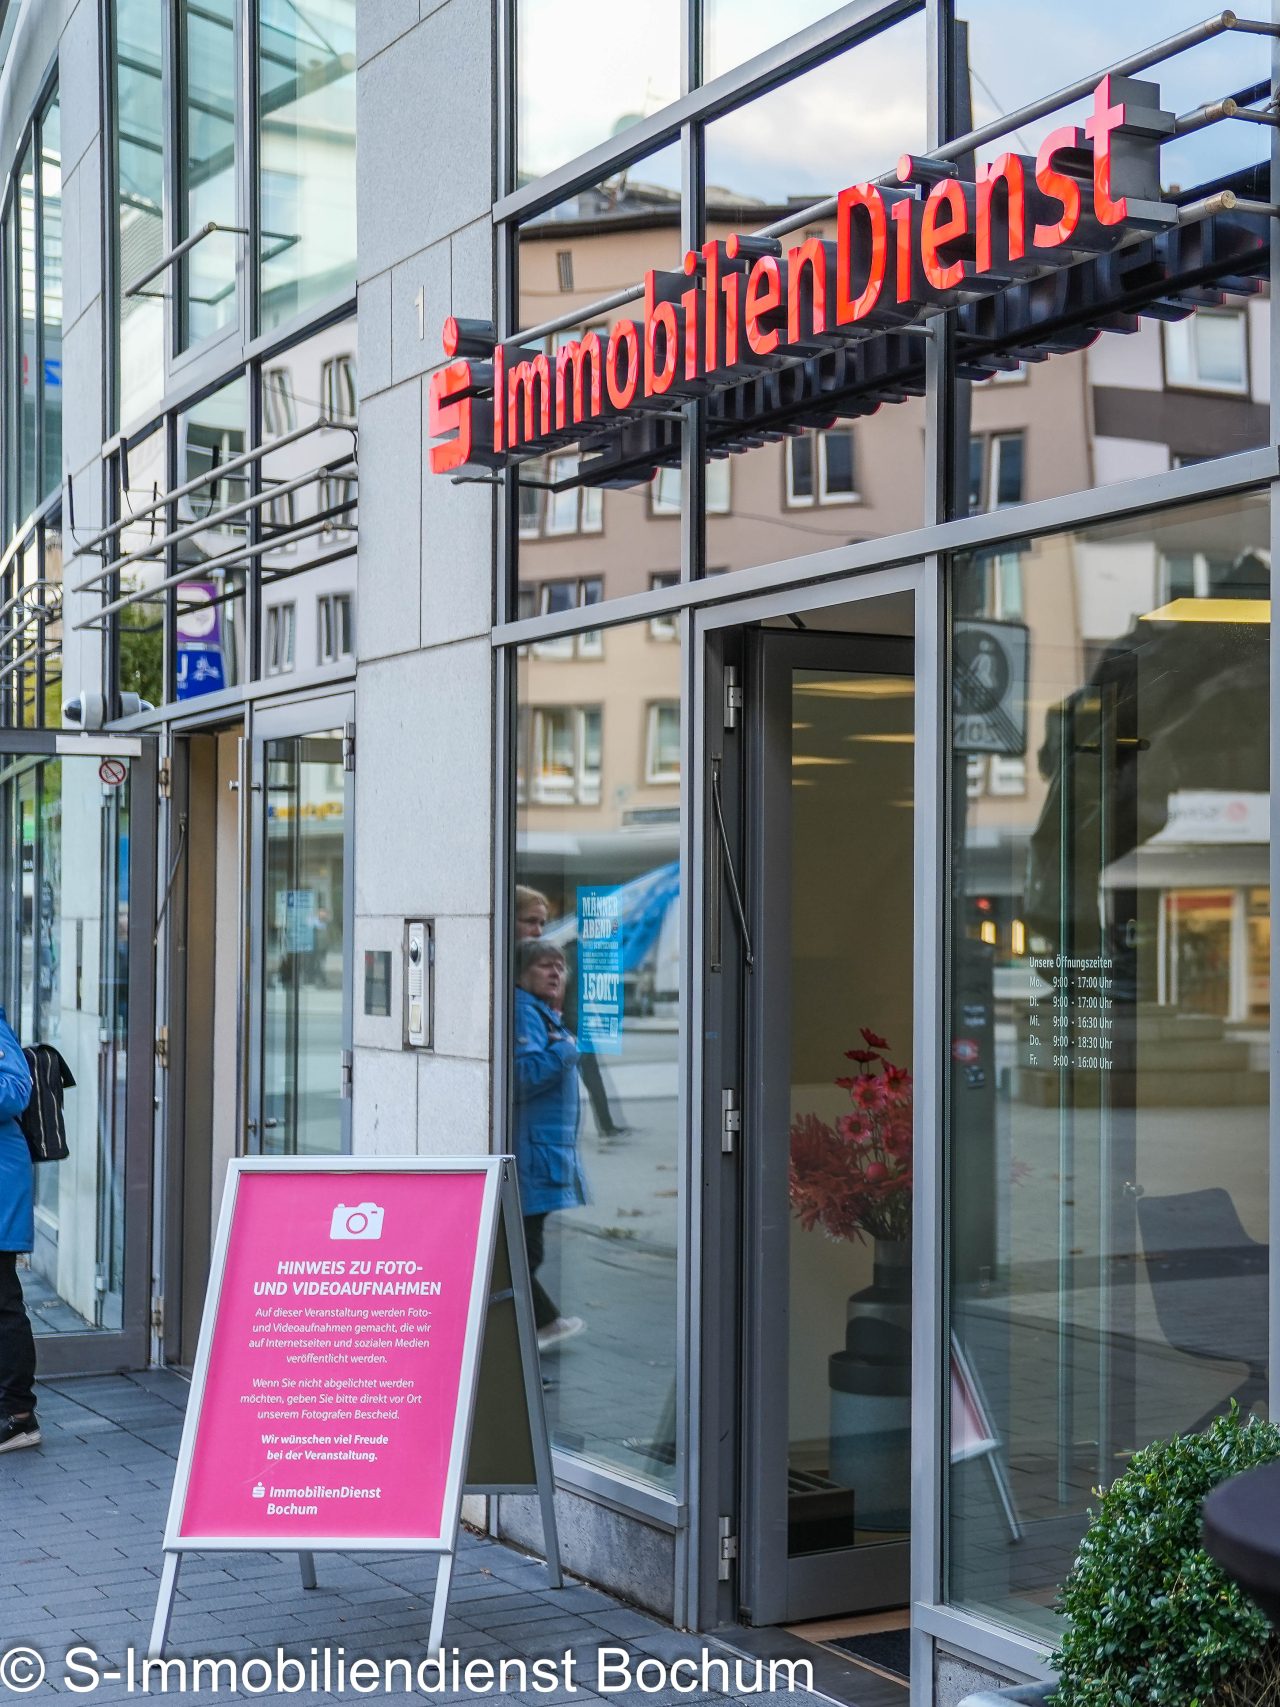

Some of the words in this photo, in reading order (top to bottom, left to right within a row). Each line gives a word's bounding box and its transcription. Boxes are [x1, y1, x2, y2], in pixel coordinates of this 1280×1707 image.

[493, 73, 1128, 454] ImmobilienDienst
[582, 918, 612, 939] ABEND
[1030, 957, 1054, 968] Unsere
[1056, 954, 1112, 970] Öffnungszeiten
[1030, 976, 1041, 987] Mo.
[1053, 976, 1068, 987] 9:00
[1078, 977, 1097, 988] 17:00
[1099, 977, 1112, 988] Uhr
[1030, 996, 1039, 1007] Di.
[1053, 996, 1068, 1007] 9:00
[1078, 997, 1097, 1008] 17:00
[1099, 997, 1112, 1009] Uhr
[1030, 1015, 1040, 1026] Mi.
[1053, 1016, 1068, 1027] 9:00
[1078, 1017, 1097, 1028] 16:30
[1099, 1017, 1112, 1029] Uhr
[1030, 1035, 1041, 1045] Do.
[1053, 1036, 1068, 1047] 9:00
[1078, 1037, 1097, 1048] 18:30
[1099, 1037, 1112, 1049] Uhr
[1053, 1055, 1068, 1066] 9:00
[1078, 1056, 1097, 1067] 16:00
[1099, 1057, 1112, 1069] Uhr
[277, 1261, 345, 1275] HINWEIS
[350, 1261, 371, 1275] ZU
[375, 1261, 423, 1275] FOTO-
[253, 1282, 287, 1296] UND
[293, 1282, 441, 1296] VIDEOAUFNAHMEN
[256, 1308, 273, 1318] Auf
[274, 1308, 302, 1318] dieser
[304, 1308, 369, 1320] Veranstaltung
[371, 1308, 405, 1318] werden
[408, 1308, 432, 1318] Foto-
[252, 1323, 272, 1333] und
[273, 1323, 352, 1333] Videoaufnahmen
[354, 1323, 398, 1335] gemacht,
[400, 1323, 415, 1333] die
[416, 1323, 432, 1333] wir
[249, 1338, 265, 1348] auf
[266, 1338, 332, 1348] Internetseiten
[333, 1338, 352, 1348] und
[354, 1338, 393, 1348] sozialen
[395, 1338, 430, 1348] Medien
[287, 1354, 349, 1364] veröffentlicht
[350, 1354, 387, 1364] werden.
[252, 1379, 280, 1388] Wenn
[282, 1379, 296, 1388] Sie
[298, 1379, 322, 1388] nicht
[324, 1379, 378, 1390] abgelichtet
[379, 1379, 414, 1388] werden
[240, 1394, 285, 1405] möchten,
[287, 1394, 318, 1406] geben
[319, 1394, 333, 1403] Sie
[335, 1394, 357, 1403] bitte
[360, 1394, 388, 1403] direkt
[389, 1394, 404, 1403] vor
[406, 1394, 422, 1403] Ort
[257, 1410, 300, 1420] unserem
[301, 1410, 353, 1421] Fotografen
[355, 1410, 400, 1420] Bescheid.
[261, 1434, 279, 1445] Wir
[280, 1434, 332, 1445] wünschen
[334, 1434, 352, 1445] viel
[354, 1434, 389, 1445] Freude
[267, 1451, 283, 1460] bei
[285, 1451, 302, 1460] der
[304, 1451, 378, 1462] Veranstaltung.
[269, 1486, 381, 1499] ImmobilienDienst
[267, 1503, 318, 1515] Bochum
